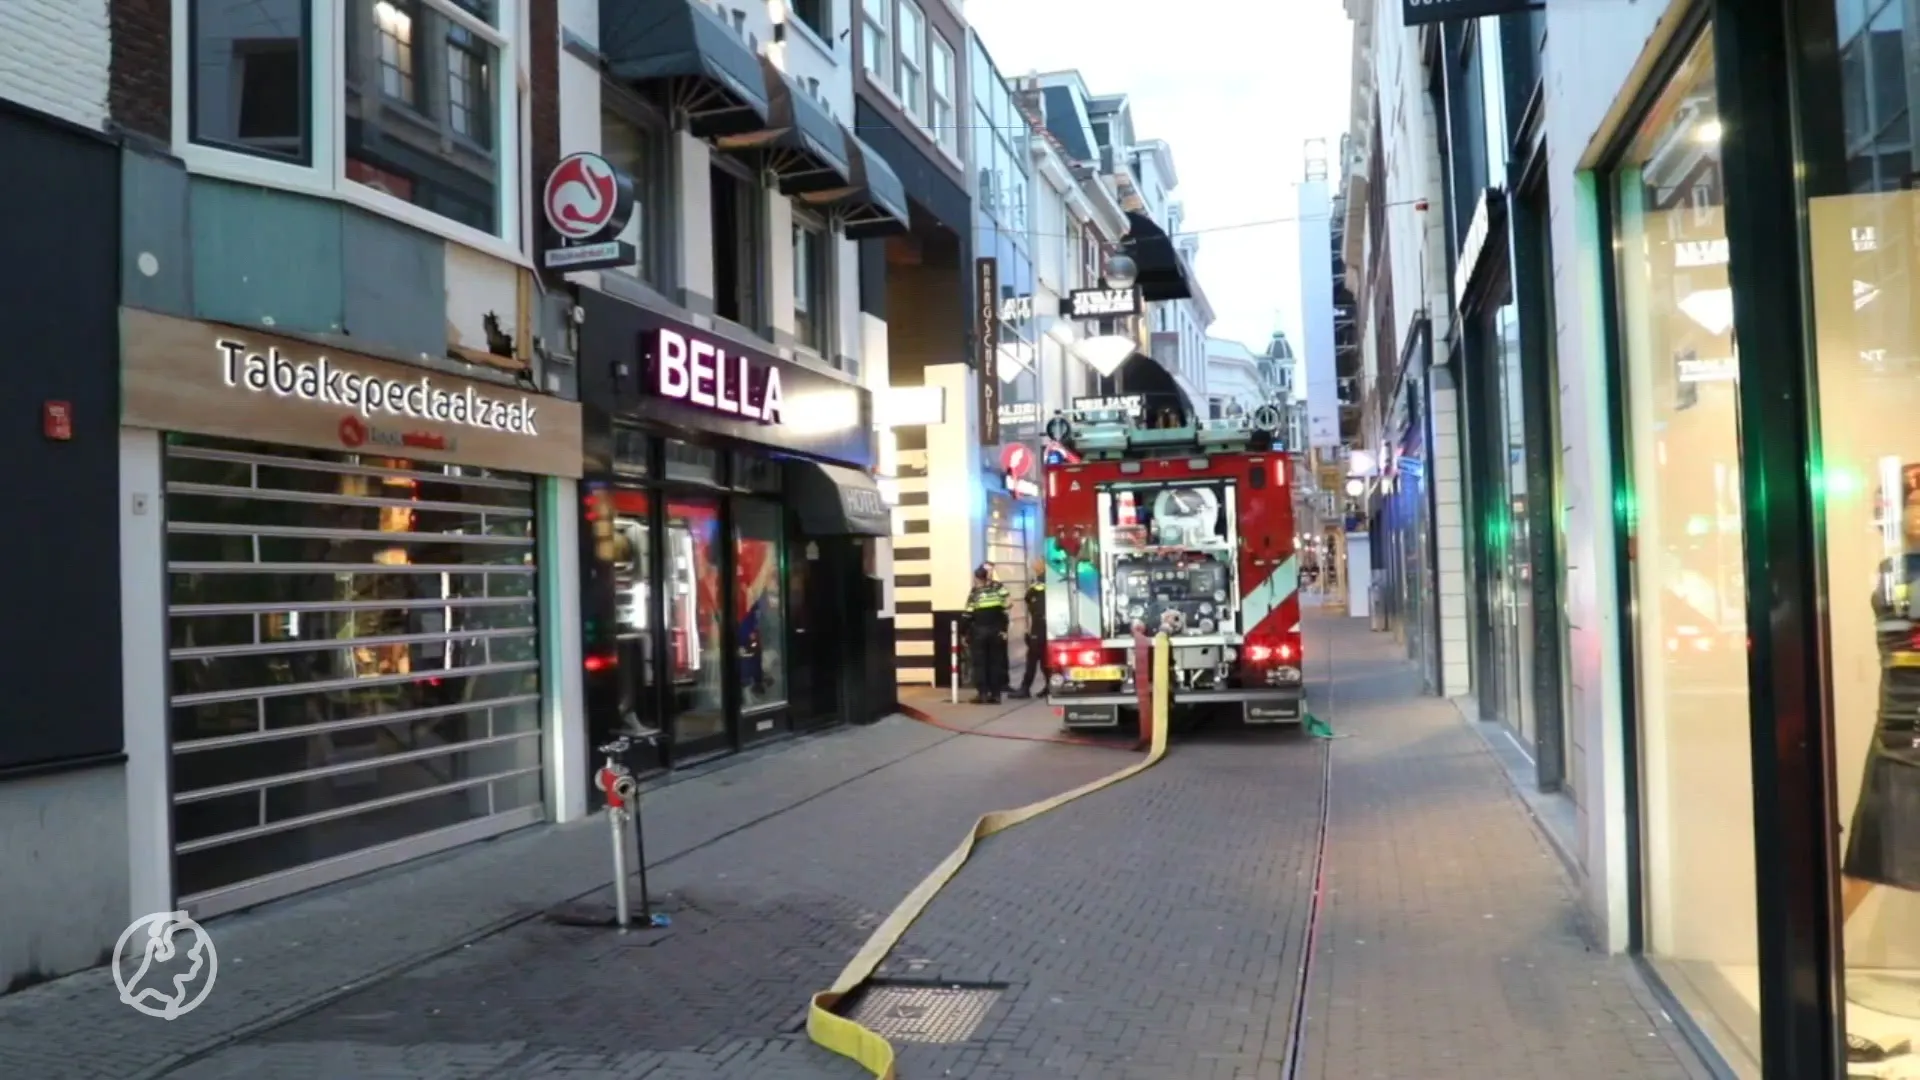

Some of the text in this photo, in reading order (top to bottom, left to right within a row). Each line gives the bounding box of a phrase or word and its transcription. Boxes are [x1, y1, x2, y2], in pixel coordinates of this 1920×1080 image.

[215, 338, 539, 436] Tabakspeciaalzaak
[659, 327, 783, 425] BELLA
[847, 489, 883, 515] HOTEL
